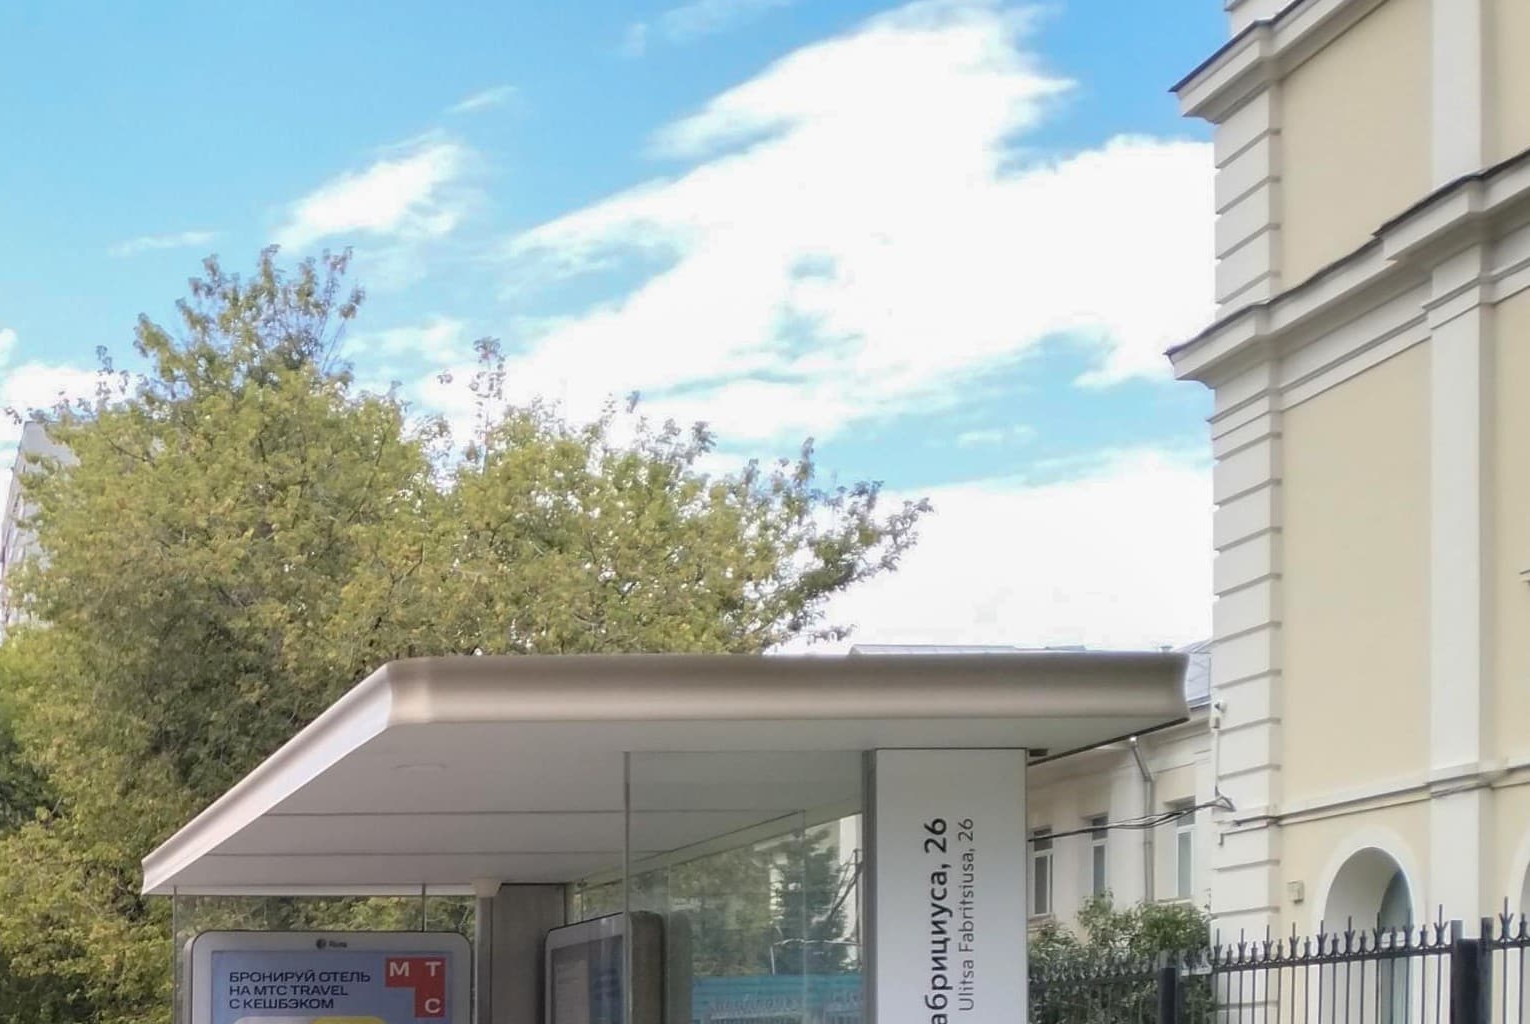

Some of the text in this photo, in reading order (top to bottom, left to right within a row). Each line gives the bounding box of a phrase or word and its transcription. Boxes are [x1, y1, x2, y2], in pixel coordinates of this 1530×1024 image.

[924, 817, 947, 854] 26
[959, 818, 976, 1011] Ulitsa Fabritsiusa, 26
[229, 969, 371, 983] БРОНИРУЙ ОТЕЛЬ
[229, 985, 348, 996] НА МТС TRAVEL
[229, 999, 334, 1009] С КЕШБЭКОМ
